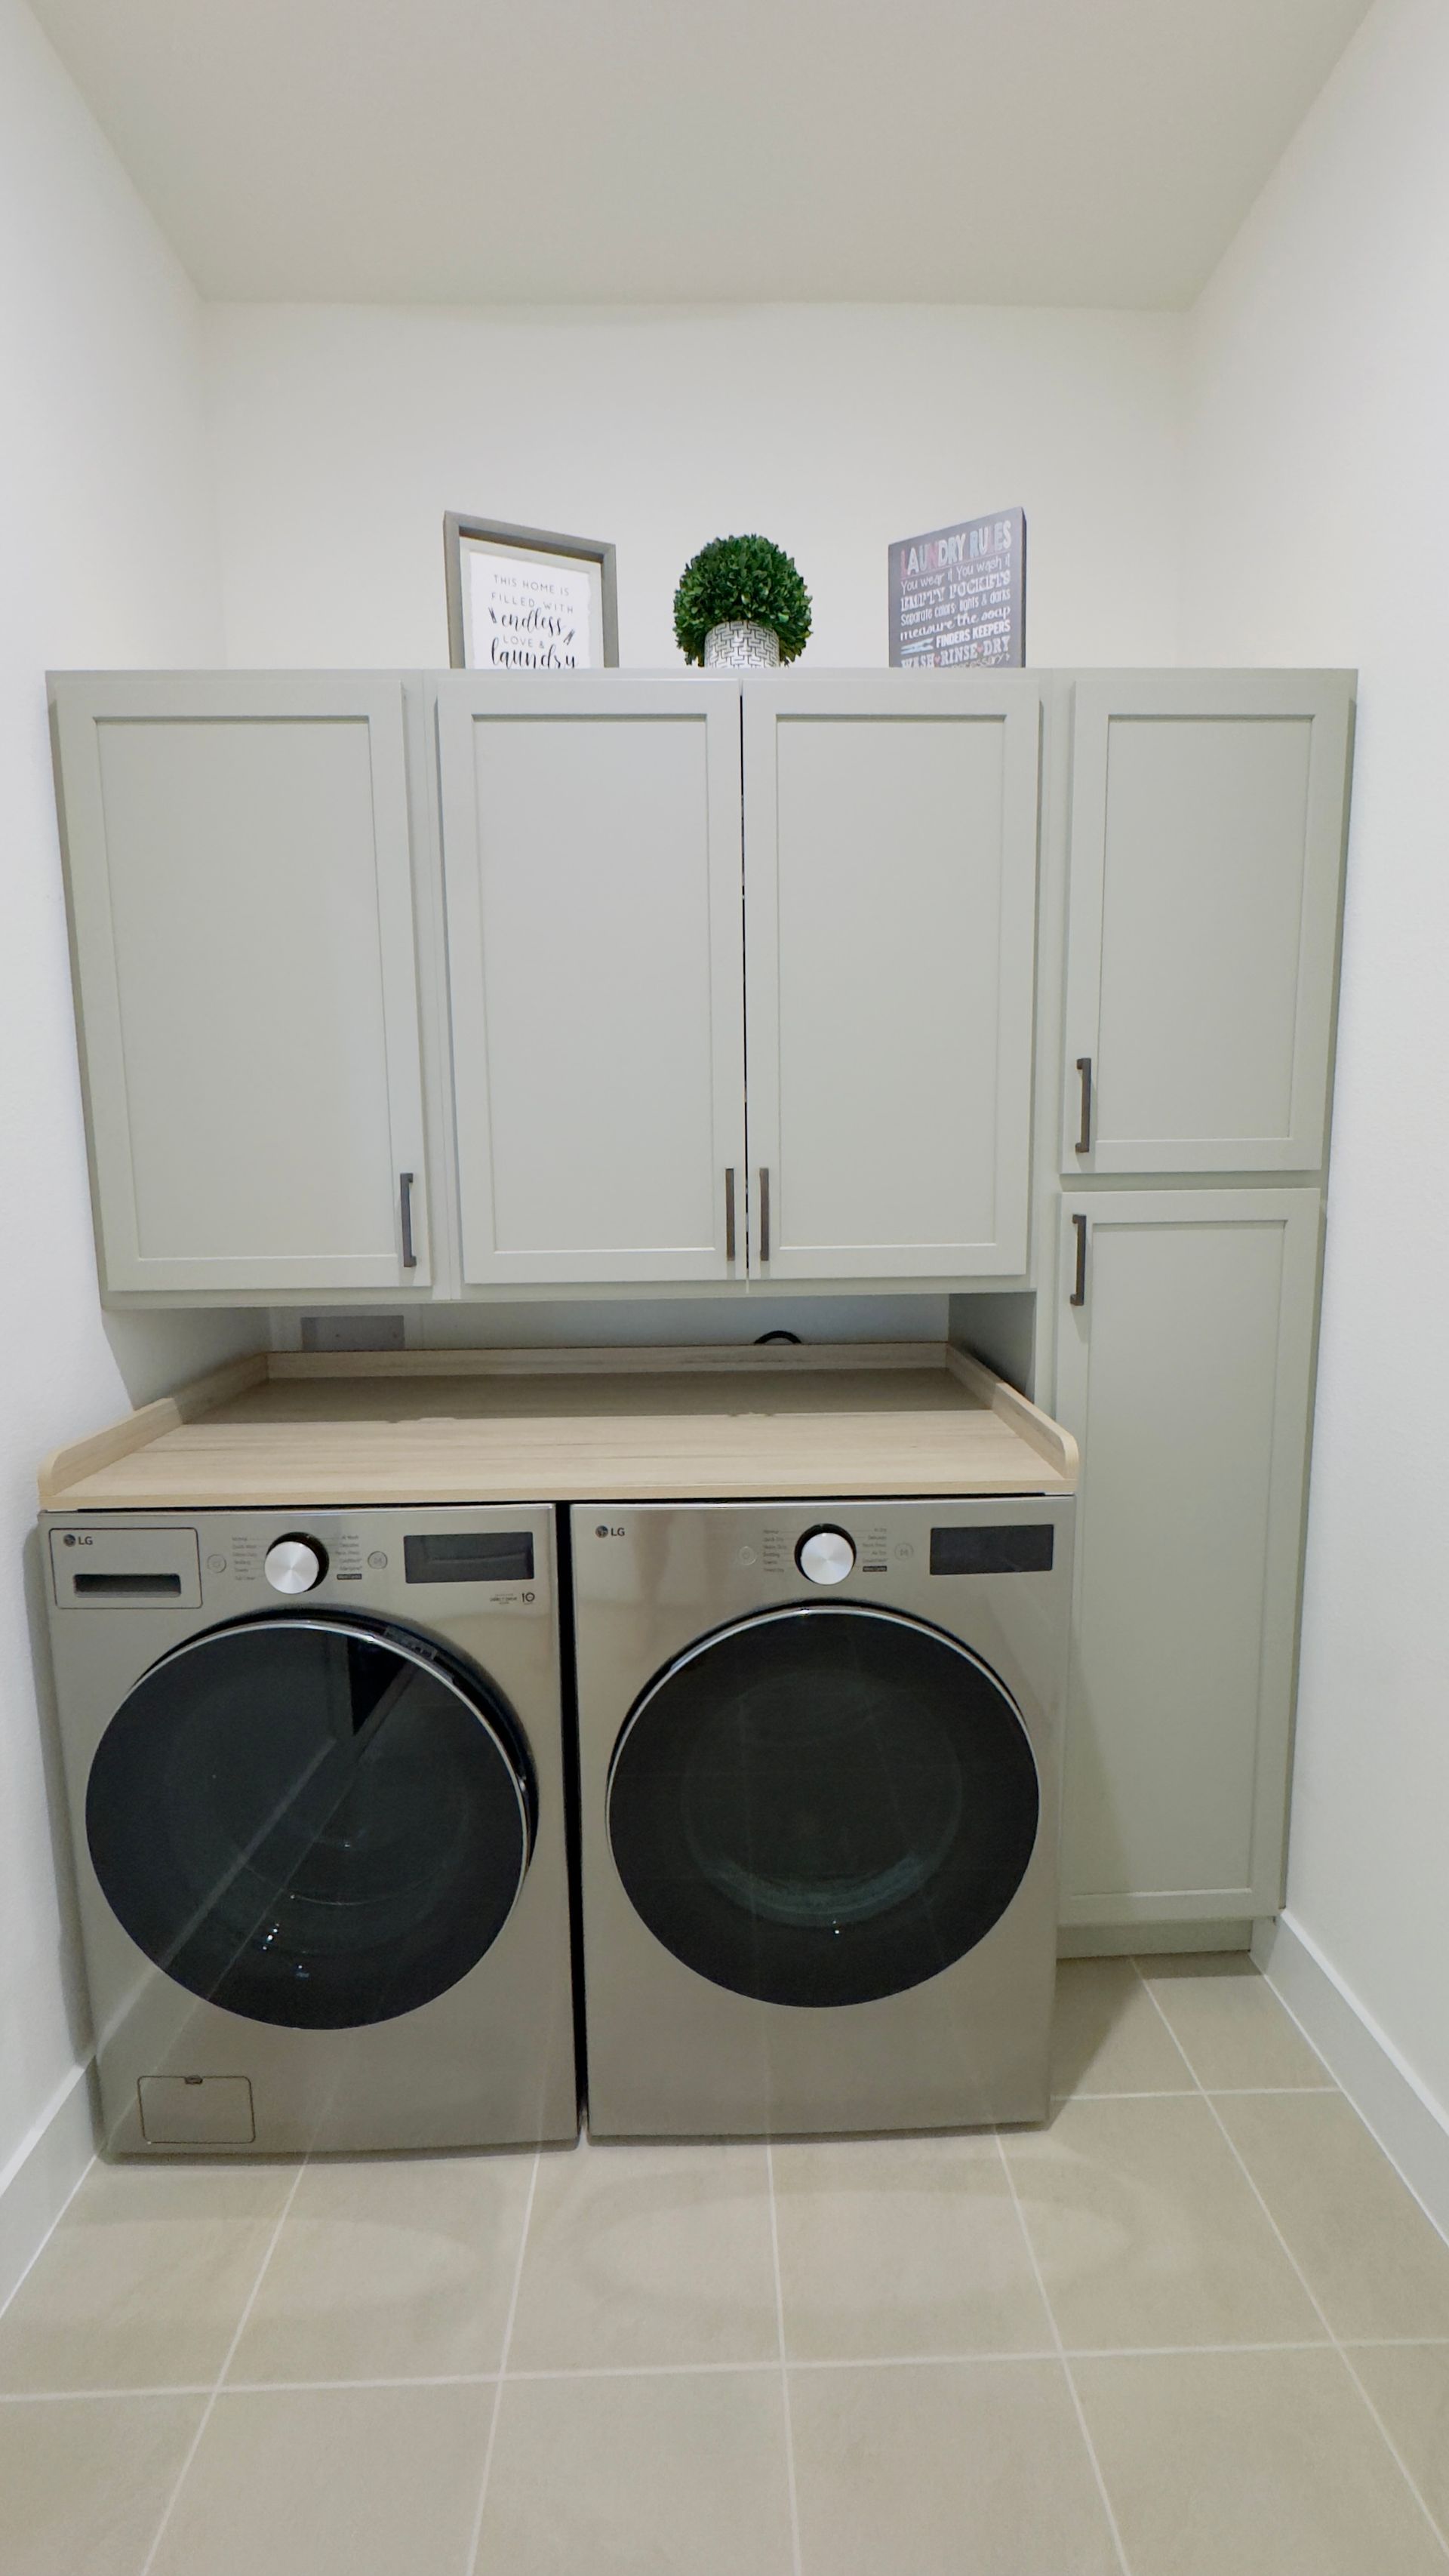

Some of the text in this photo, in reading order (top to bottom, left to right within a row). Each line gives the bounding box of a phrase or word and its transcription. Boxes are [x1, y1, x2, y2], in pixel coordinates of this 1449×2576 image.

[900, 520, 1011, 579] LAUNDRY RULES
[494, 574, 570, 596] THIS HOME IS
[900, 569, 1011, 612] EMPTY POCKETS
[901, 579, 918, 596] You
[921, 573, 945, 587] wear
[956, 565, 974, 580] You
[977, 556, 1002, 573] wash
[491, 592, 574, 614] FILLED WITH
[501, 607, 561, 637] endless
[900, 605, 1011, 642] measure the soap
[936, 620, 1011, 648] FINDERS KEEPERS
[491, 636, 575, 669] laundry
[503, 635, 533, 647] LOVE
[940, 643, 978, 666] RINSE
[983, 636, 1011, 657] DRY
[78, 1536, 94, 1546] LG
[611, 1527, 626, 1537] LG
